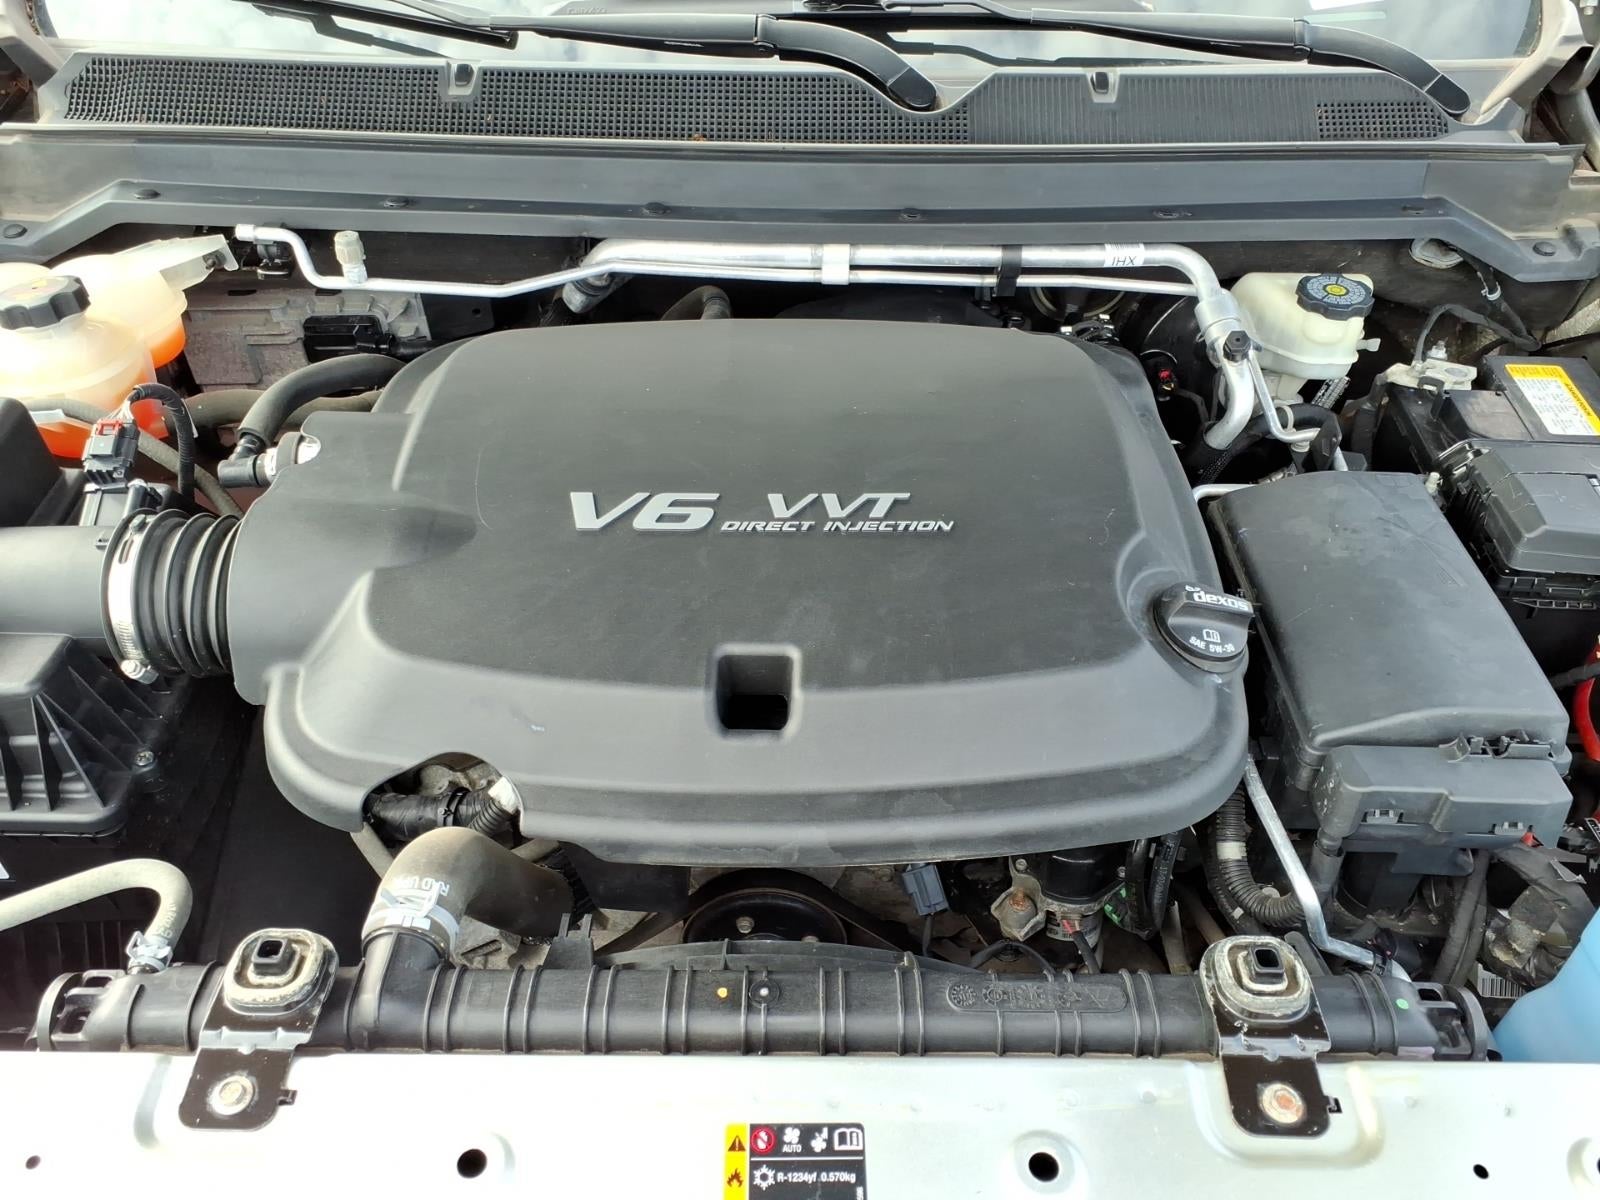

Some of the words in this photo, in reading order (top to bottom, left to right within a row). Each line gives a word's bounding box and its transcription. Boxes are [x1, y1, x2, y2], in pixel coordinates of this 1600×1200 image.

[570, 492, 720, 531] V6
[767, 493, 911, 518] VVT
[720, 520, 816, 532] DIRECT
[823, 520, 954, 532] INJECTION
[1193, 590, 1249, 611] dexos
[1189, 636, 1206, 649] SAE
[782, 1144, 802, 1153] AUTO
[777, 1171, 817, 1184] R-1234yf
[820, 1171, 856, 1183] 0.570kg
